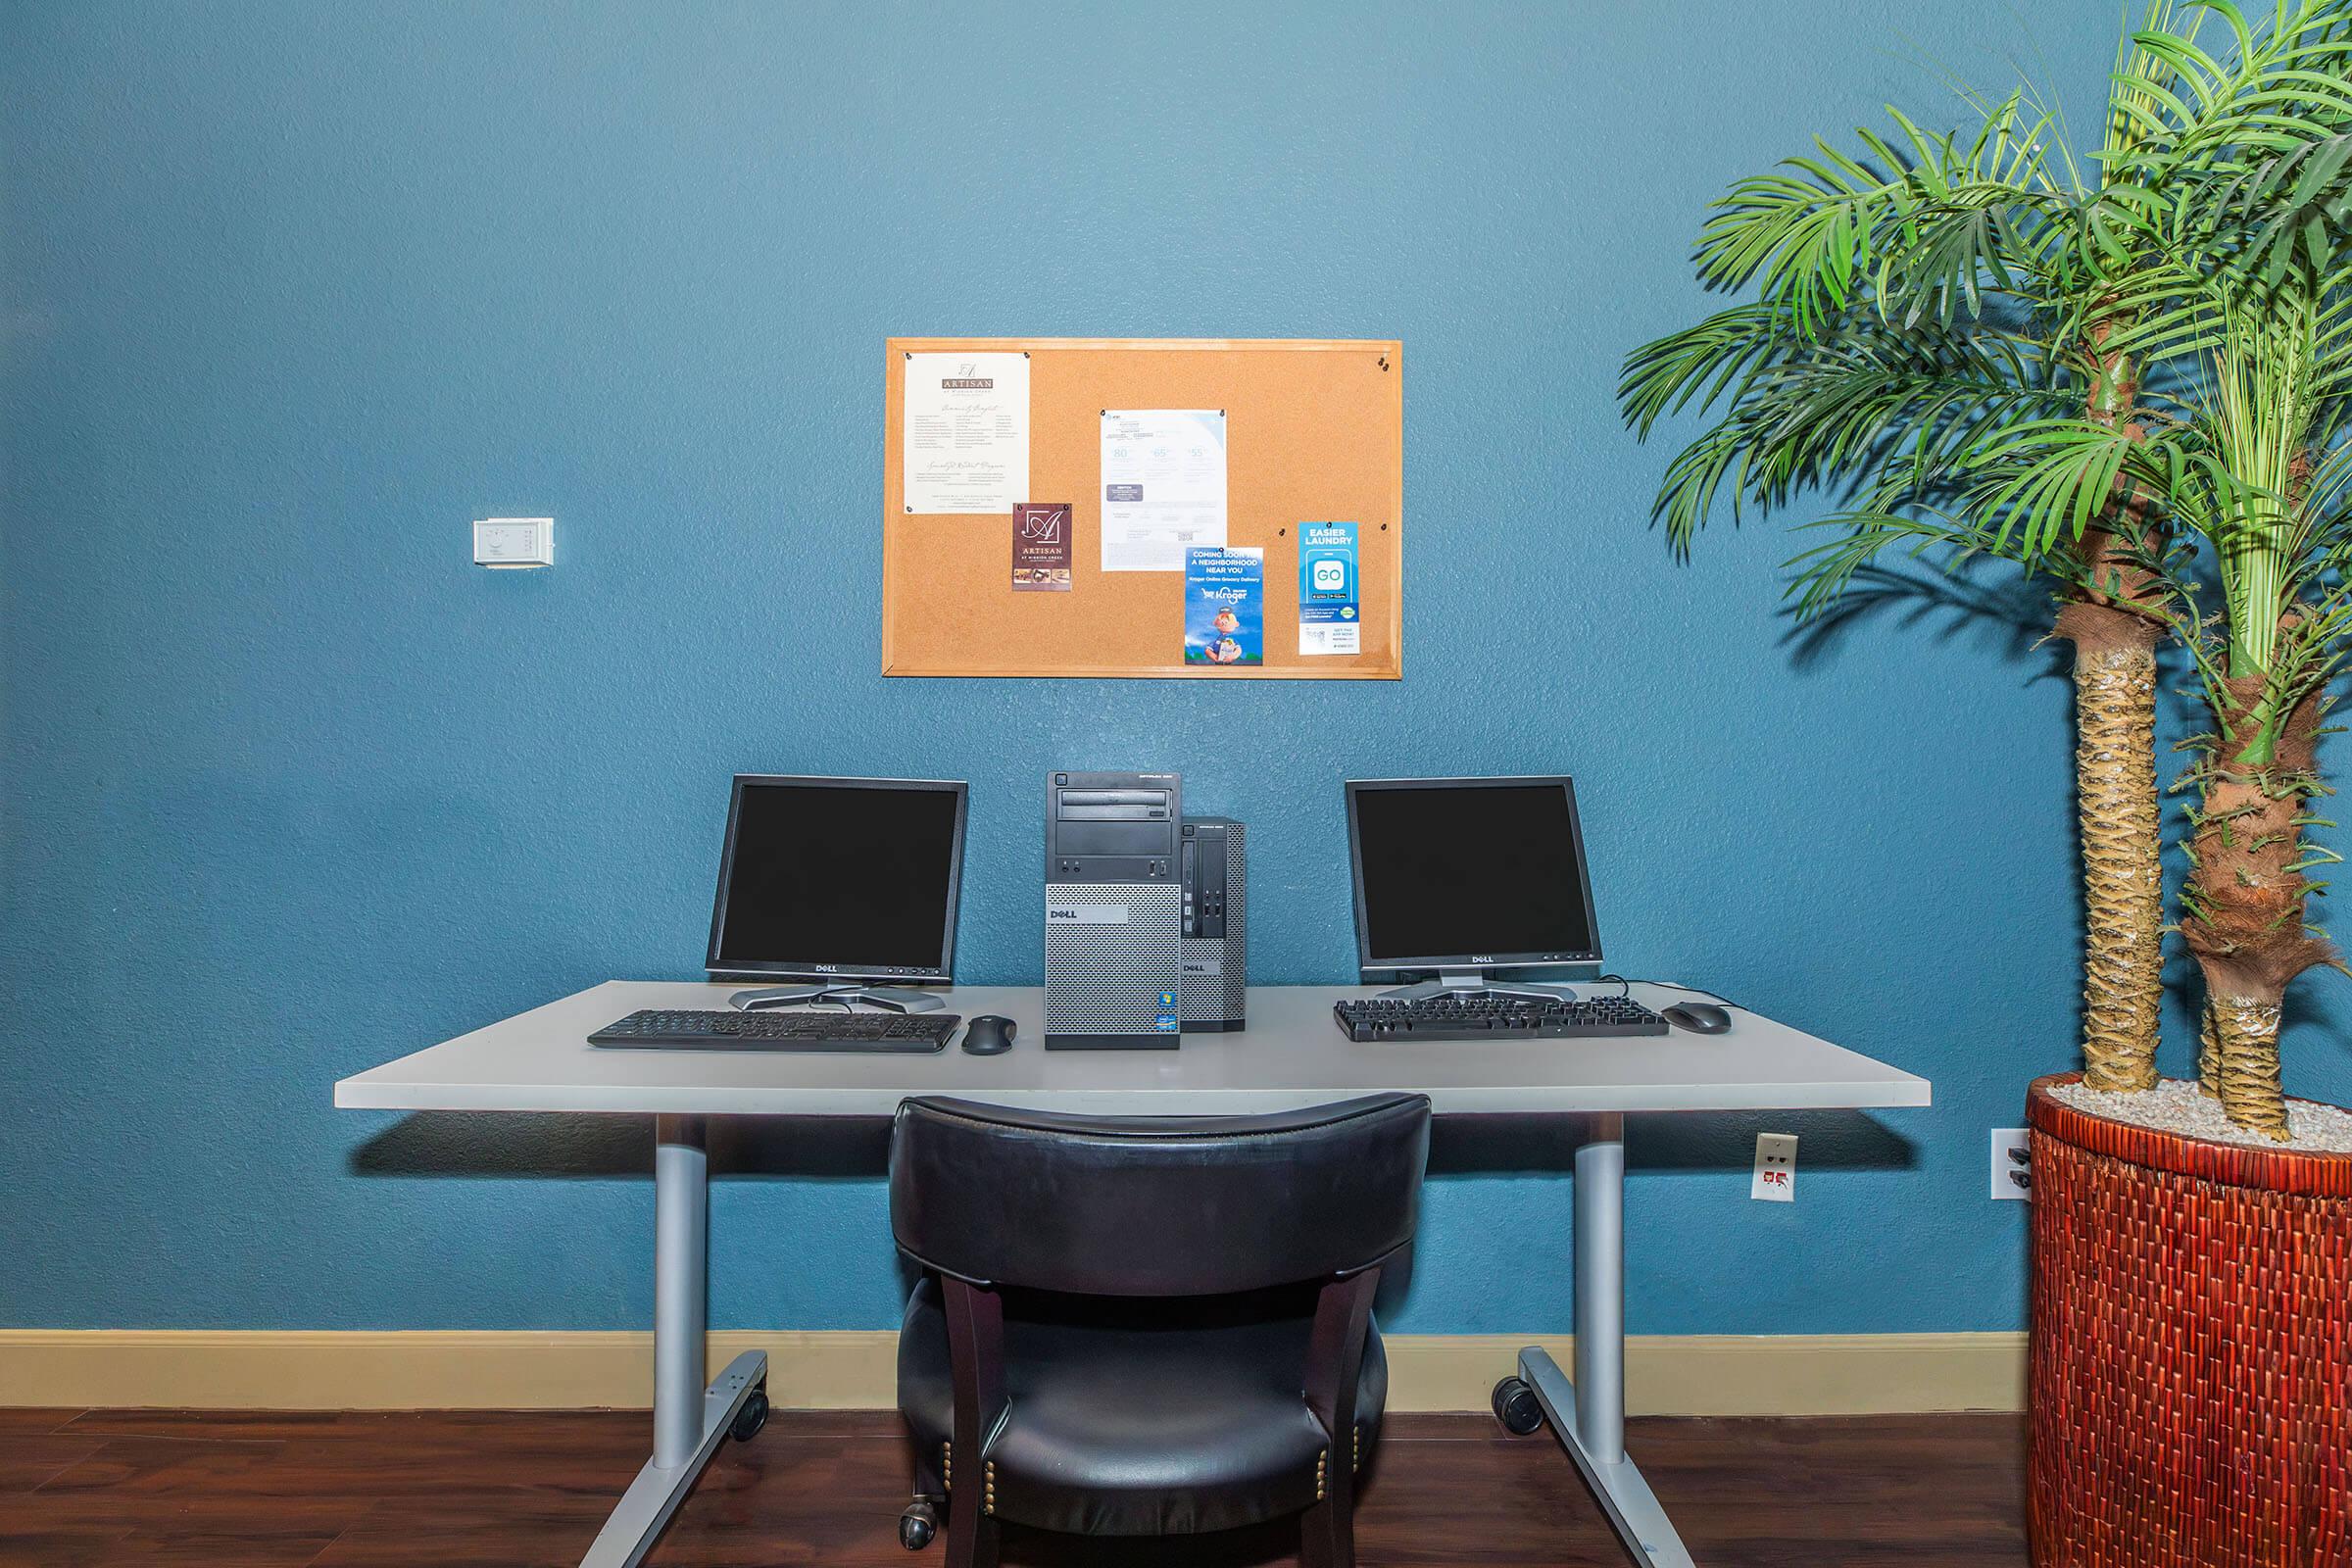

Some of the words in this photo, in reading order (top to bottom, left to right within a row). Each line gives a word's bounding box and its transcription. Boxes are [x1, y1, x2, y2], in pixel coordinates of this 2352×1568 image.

[943, 380, 992, 388] ARTISAN
[1305, 537, 1352, 545] LAUNDRY
[1317, 569, 1341, 581] GO
[1216, 587, 1247, 604] Kroger
